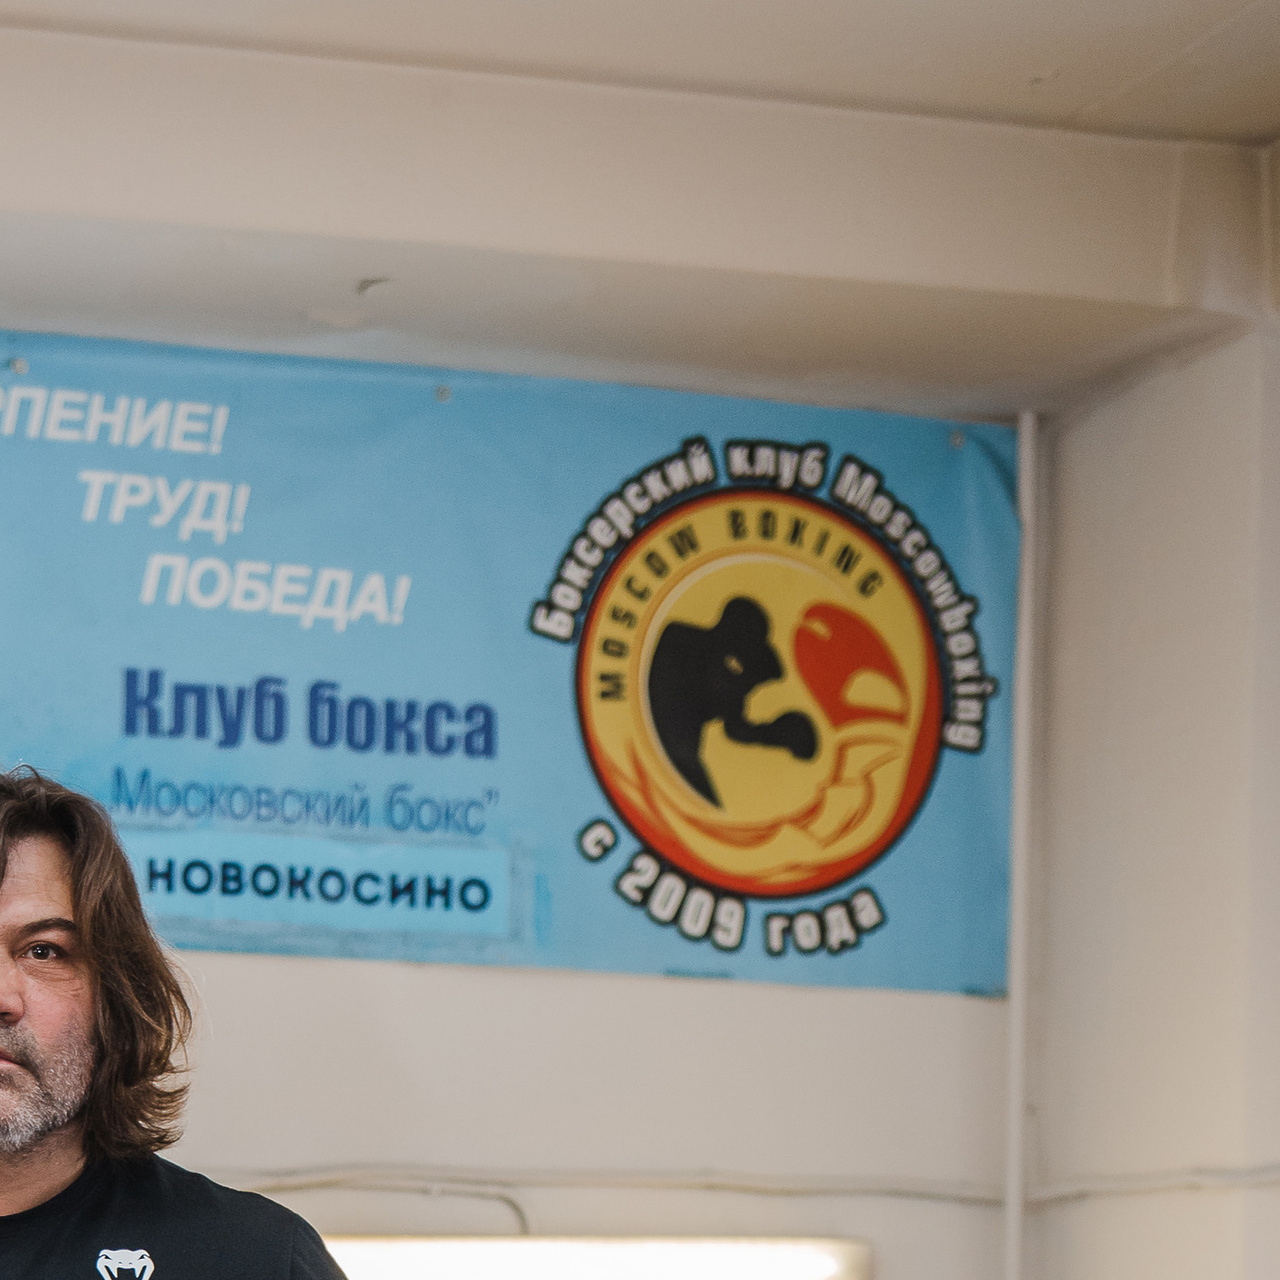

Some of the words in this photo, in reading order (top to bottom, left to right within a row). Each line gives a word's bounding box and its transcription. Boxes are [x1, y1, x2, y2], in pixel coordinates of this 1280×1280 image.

[78, 470, 251, 544] ТРУД!
[531, 438, 716, 642] Боксерский
[725, 440, 829, 489] клуб
[140, 553, 411, 632] ПОБЕДА!
[600, 524, 700, 702] MOSCOW
[727, 508, 885, 599] BOXING
[122, 667, 287, 752] Клуб
[308, 680, 499, 760] бокса
[111, 766, 372, 829] Московский
[146, 857, 492, 913] НОВОКОСИНО
[580, 820, 618, 863] с
[616, 854, 746, 952] 2009
[767, 888, 886, 956] года
